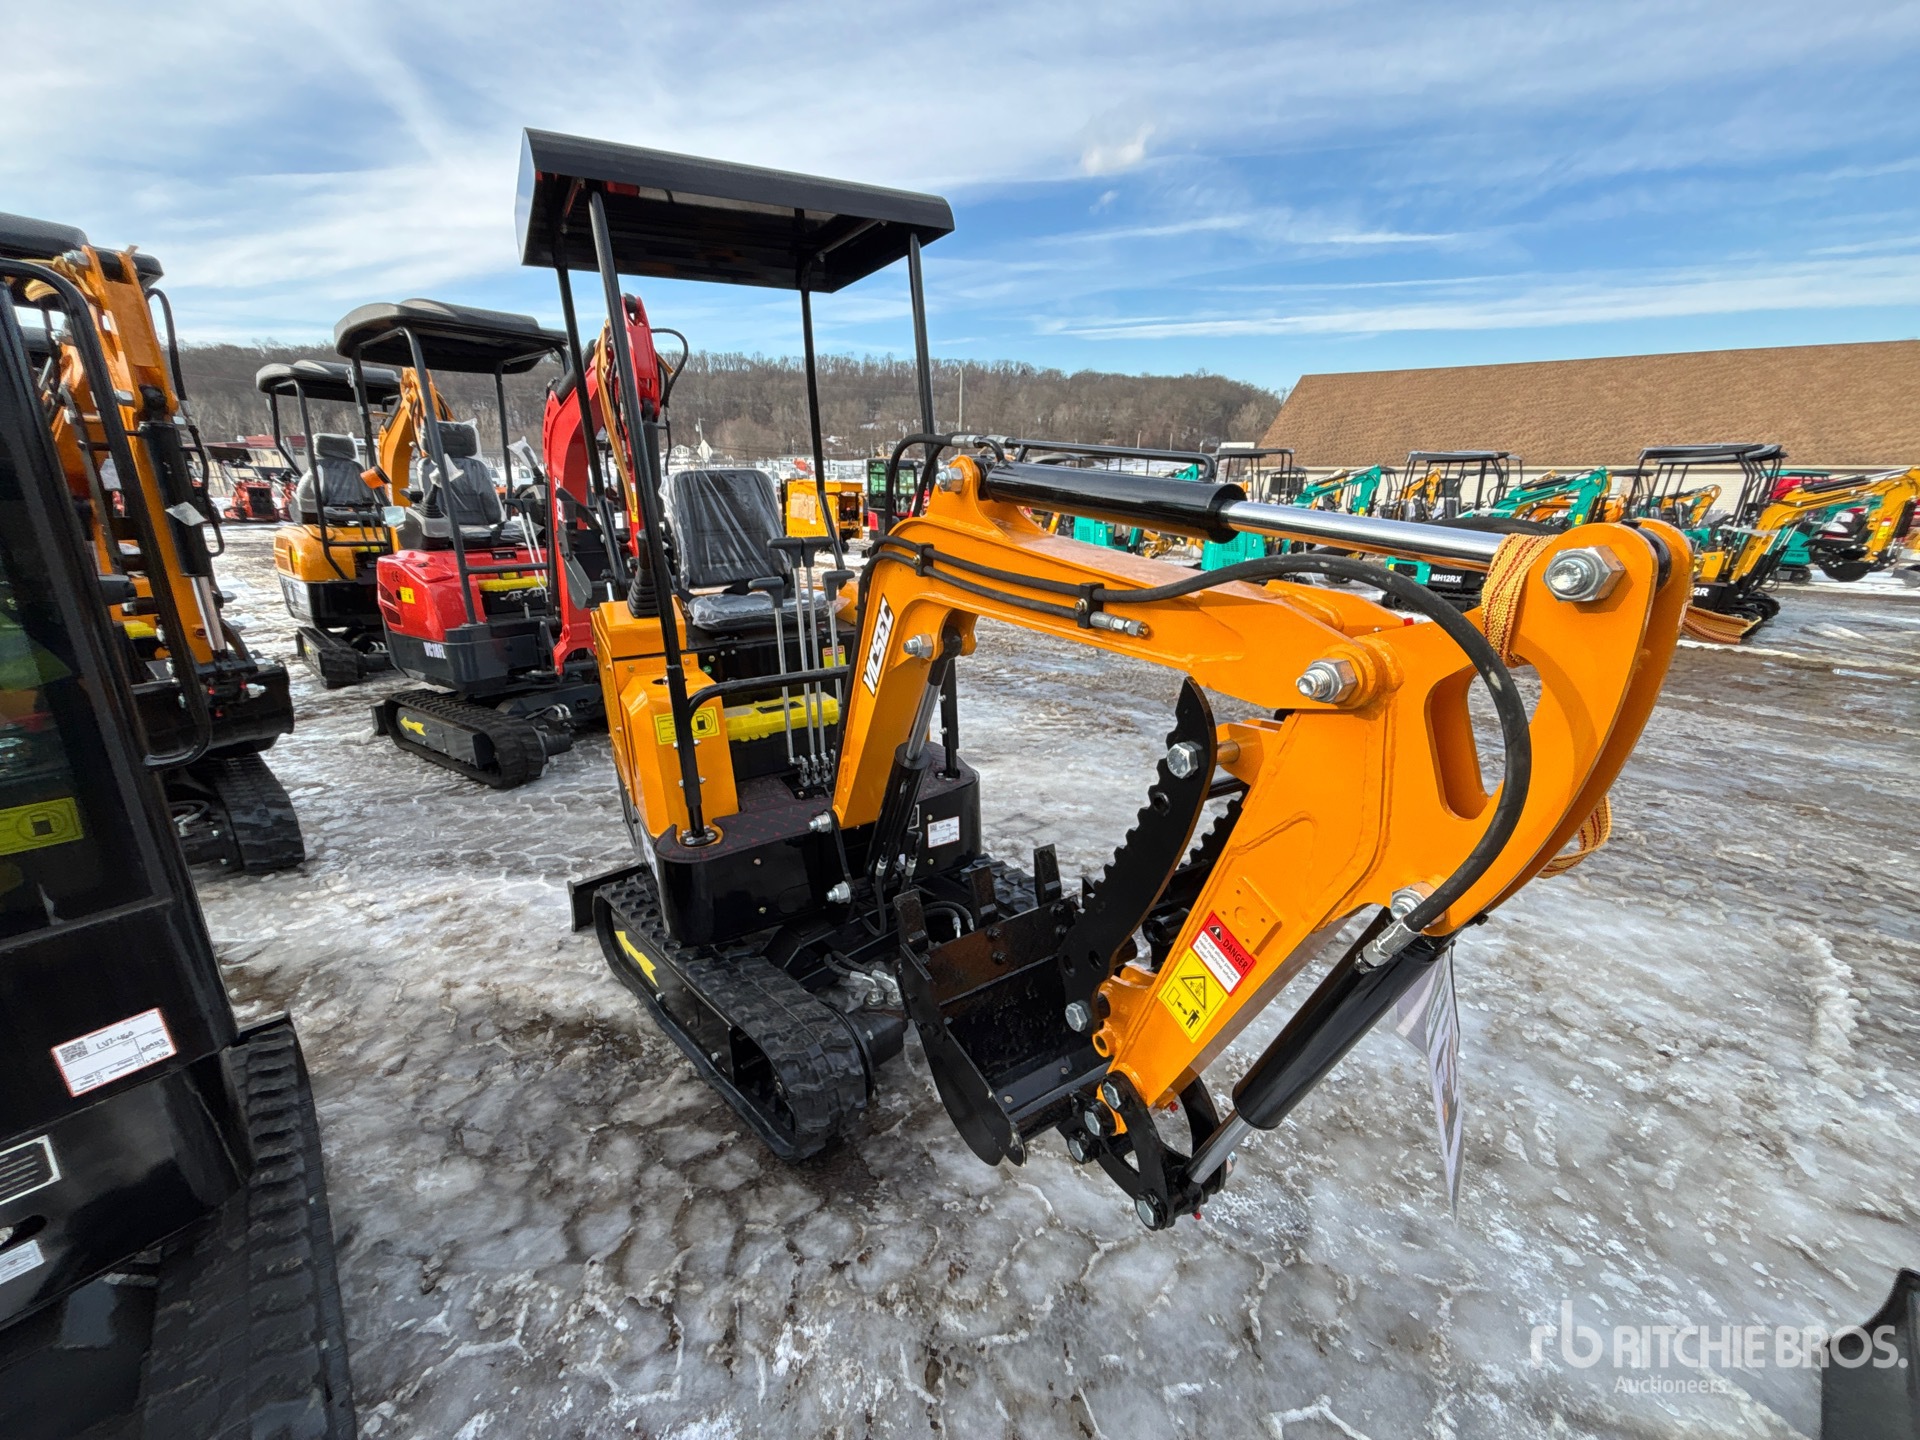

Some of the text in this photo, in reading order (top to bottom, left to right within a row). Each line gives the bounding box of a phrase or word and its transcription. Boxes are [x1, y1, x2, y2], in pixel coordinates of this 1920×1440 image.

[1431, 573, 1462, 583] MH12RX
[1692, 587, 1709, 597] 2R
[862, 594, 895, 696] VICSEC
[1222, 939, 1248, 970] DANGER
